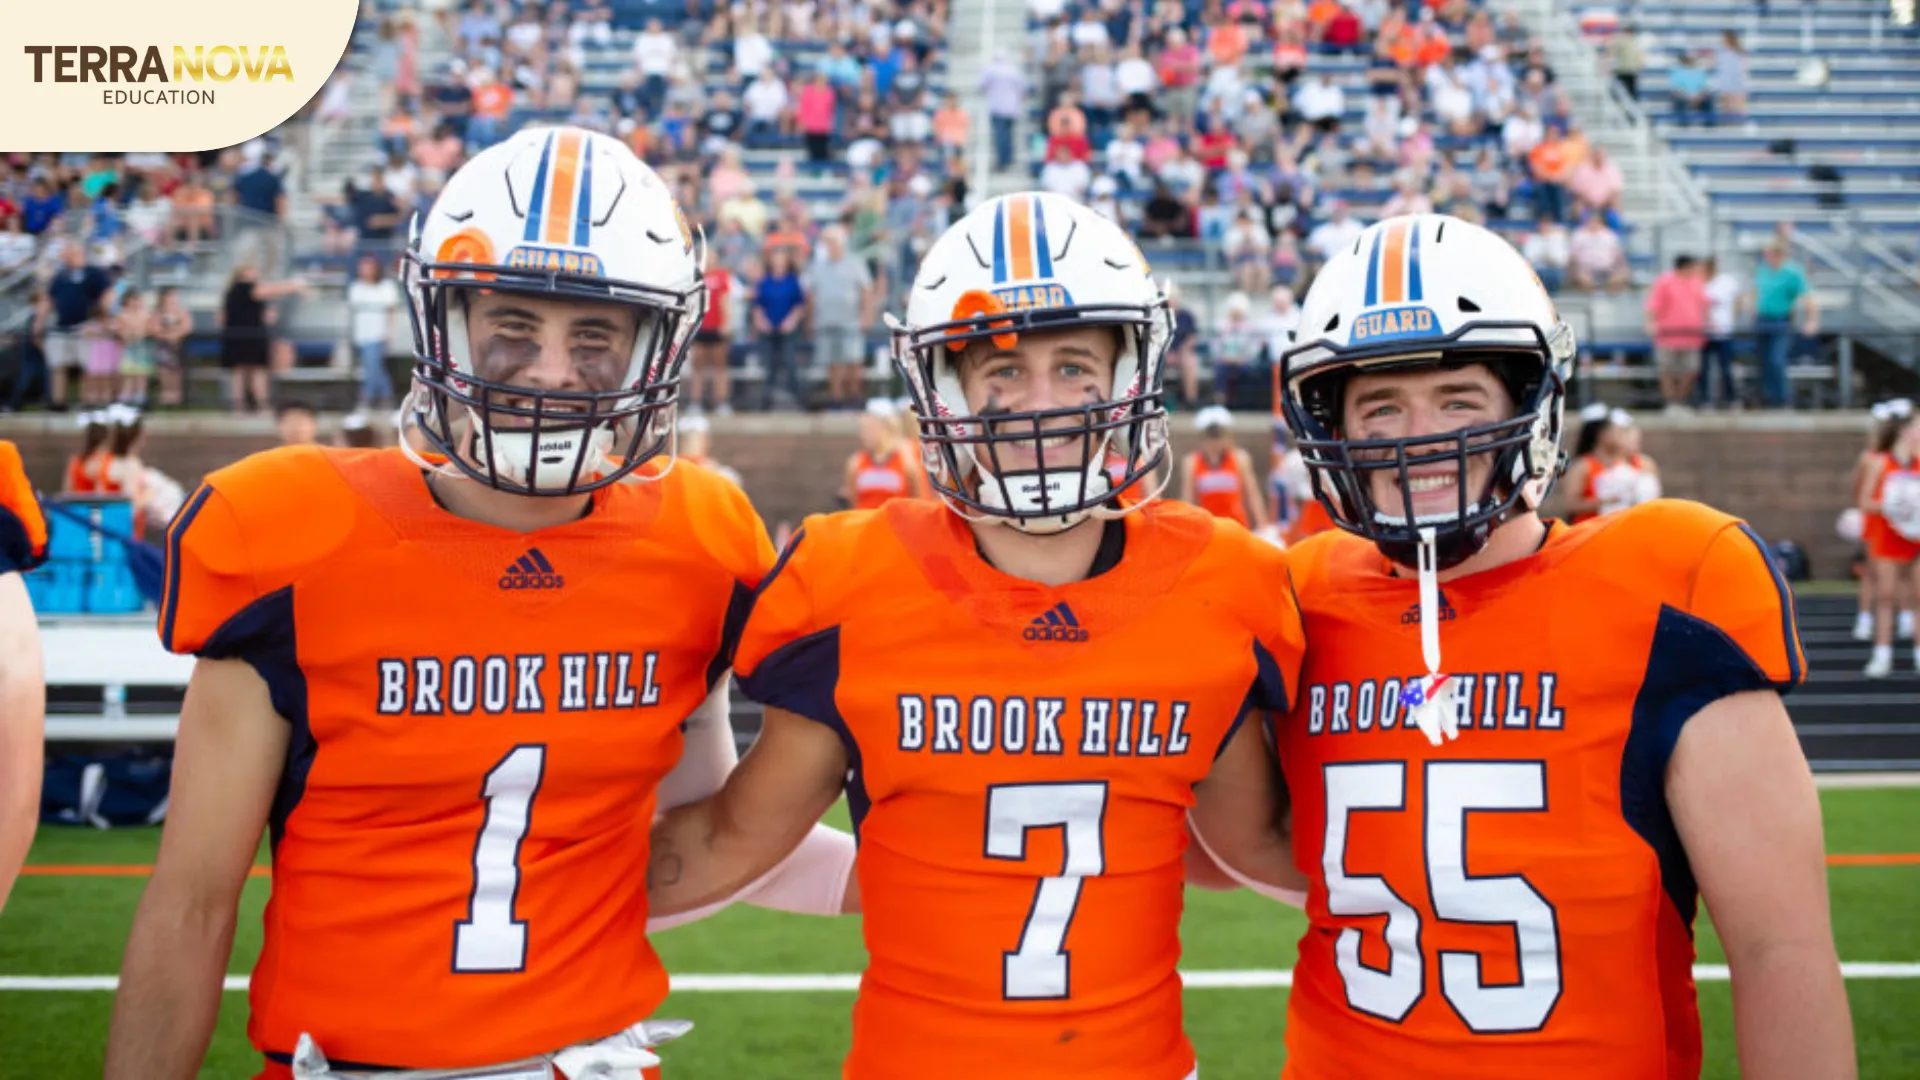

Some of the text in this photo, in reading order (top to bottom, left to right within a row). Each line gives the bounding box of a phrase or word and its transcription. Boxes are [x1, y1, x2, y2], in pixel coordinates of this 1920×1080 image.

[510, 247, 598, 276] GUARD
[999, 286, 1065, 312] UARD
[1355, 309, 1433, 339] GUARD
[498, 572, 565, 590] adidas
[1022, 624, 1089, 642] adidas
[1401, 606, 1456, 624] adas
[377, 651, 661, 714] BROOK HILL
[1450, 672, 1565, 730] HILL
[898, 694, 1190, 756] BROOK HILL
[451, 743, 547, 974] 1
[983, 780, 1109, 1000] 7
[1322, 760, 1564, 1033] 55
